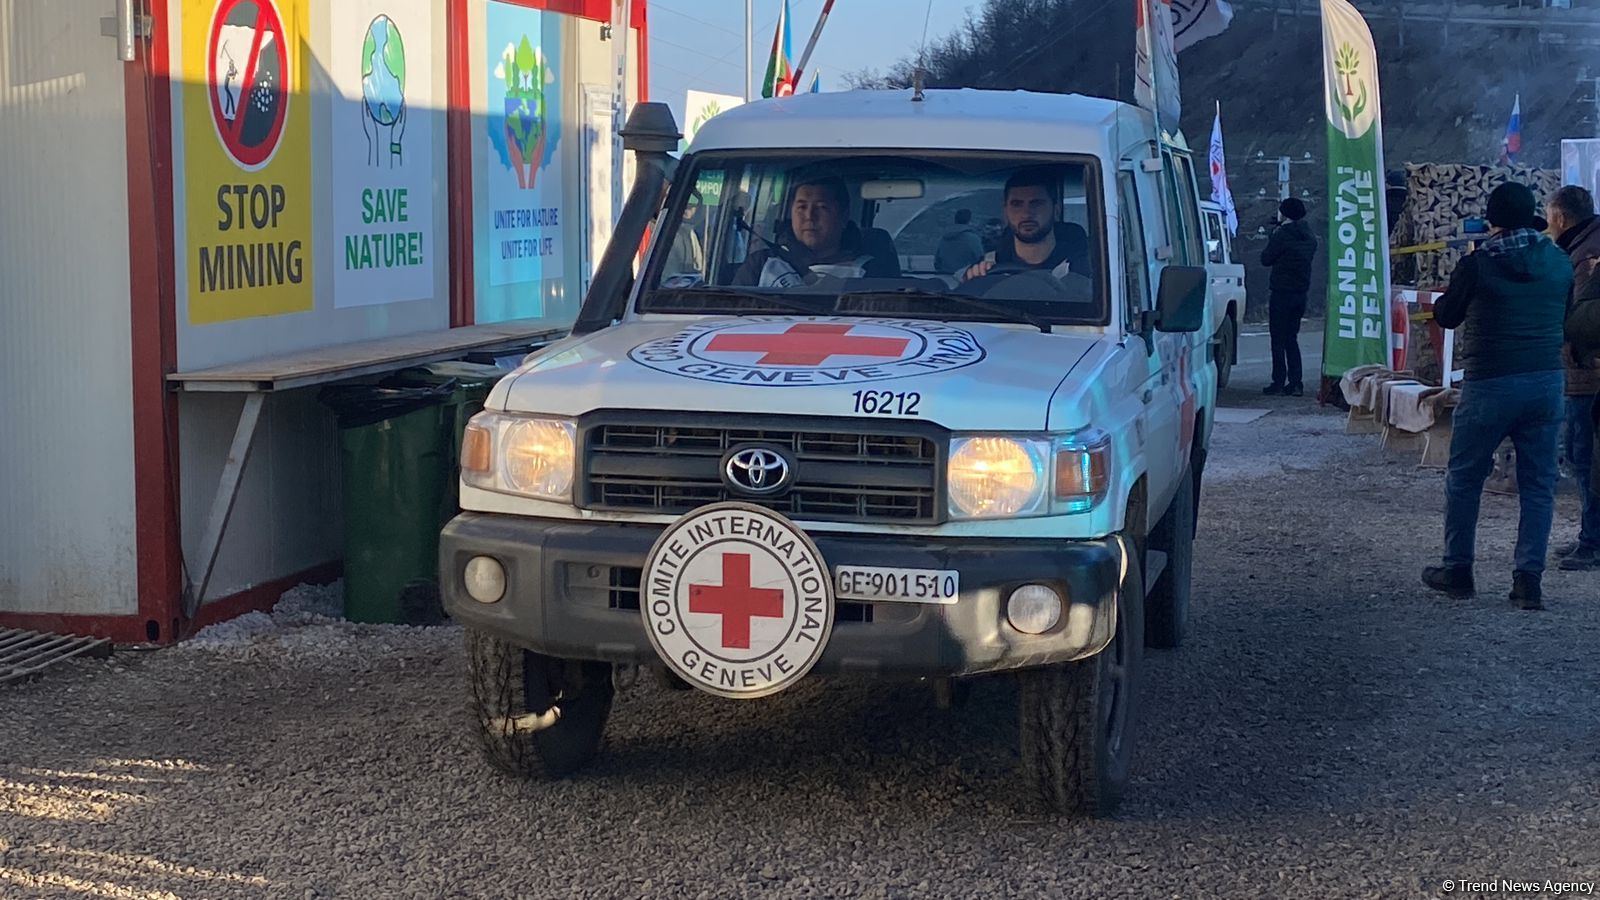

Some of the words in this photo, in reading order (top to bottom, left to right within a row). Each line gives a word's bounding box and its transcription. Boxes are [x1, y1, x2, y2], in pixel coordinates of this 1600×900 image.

[217, 184, 286, 231] STOP
[362, 188, 408, 224] SAVE
[494, 209, 515, 229] UNITE
[517, 208, 531, 228] FOR
[532, 207, 558, 227] NATURE
[199, 240, 302, 293] MINING
[345, 232, 423, 270] NATURE!
[501, 240, 522, 260] UNITE
[524, 239, 537, 257] FOR
[539, 237, 553, 256] LIFE
[678, 363, 892, 382] GENEVE
[852, 390, 921, 415] 16212
[653, 539, 690, 635] COMITE
[687, 516, 823, 643] INTERNATIONAL
[682, 649, 794, 687] GENEVE
